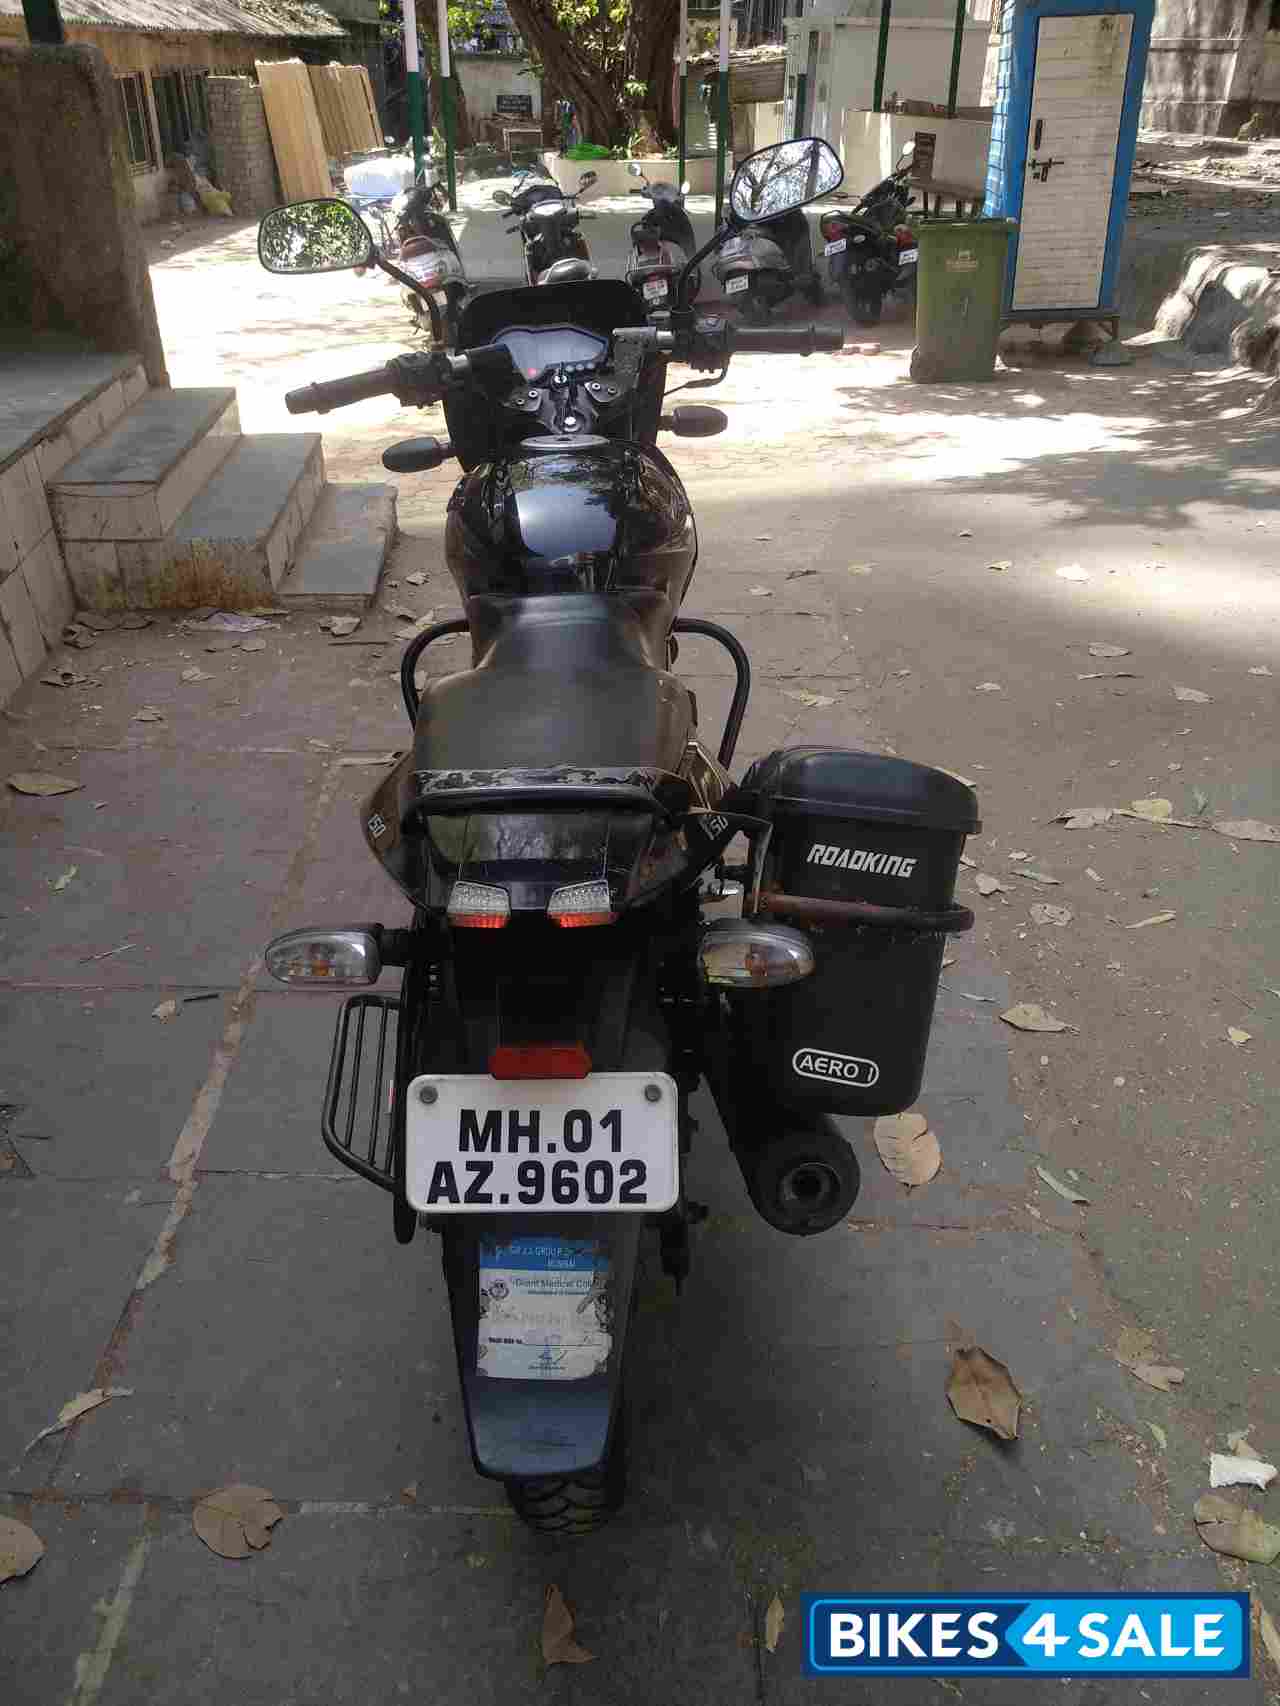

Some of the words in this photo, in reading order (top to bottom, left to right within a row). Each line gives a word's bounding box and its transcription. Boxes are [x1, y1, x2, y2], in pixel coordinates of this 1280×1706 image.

[806, 843, 918, 878] ROADKING
[799, 1054, 859, 1078] AERO
[458, 1109, 622, 1153] MH.01
[426, 1159, 648, 1205] AZ.9602
